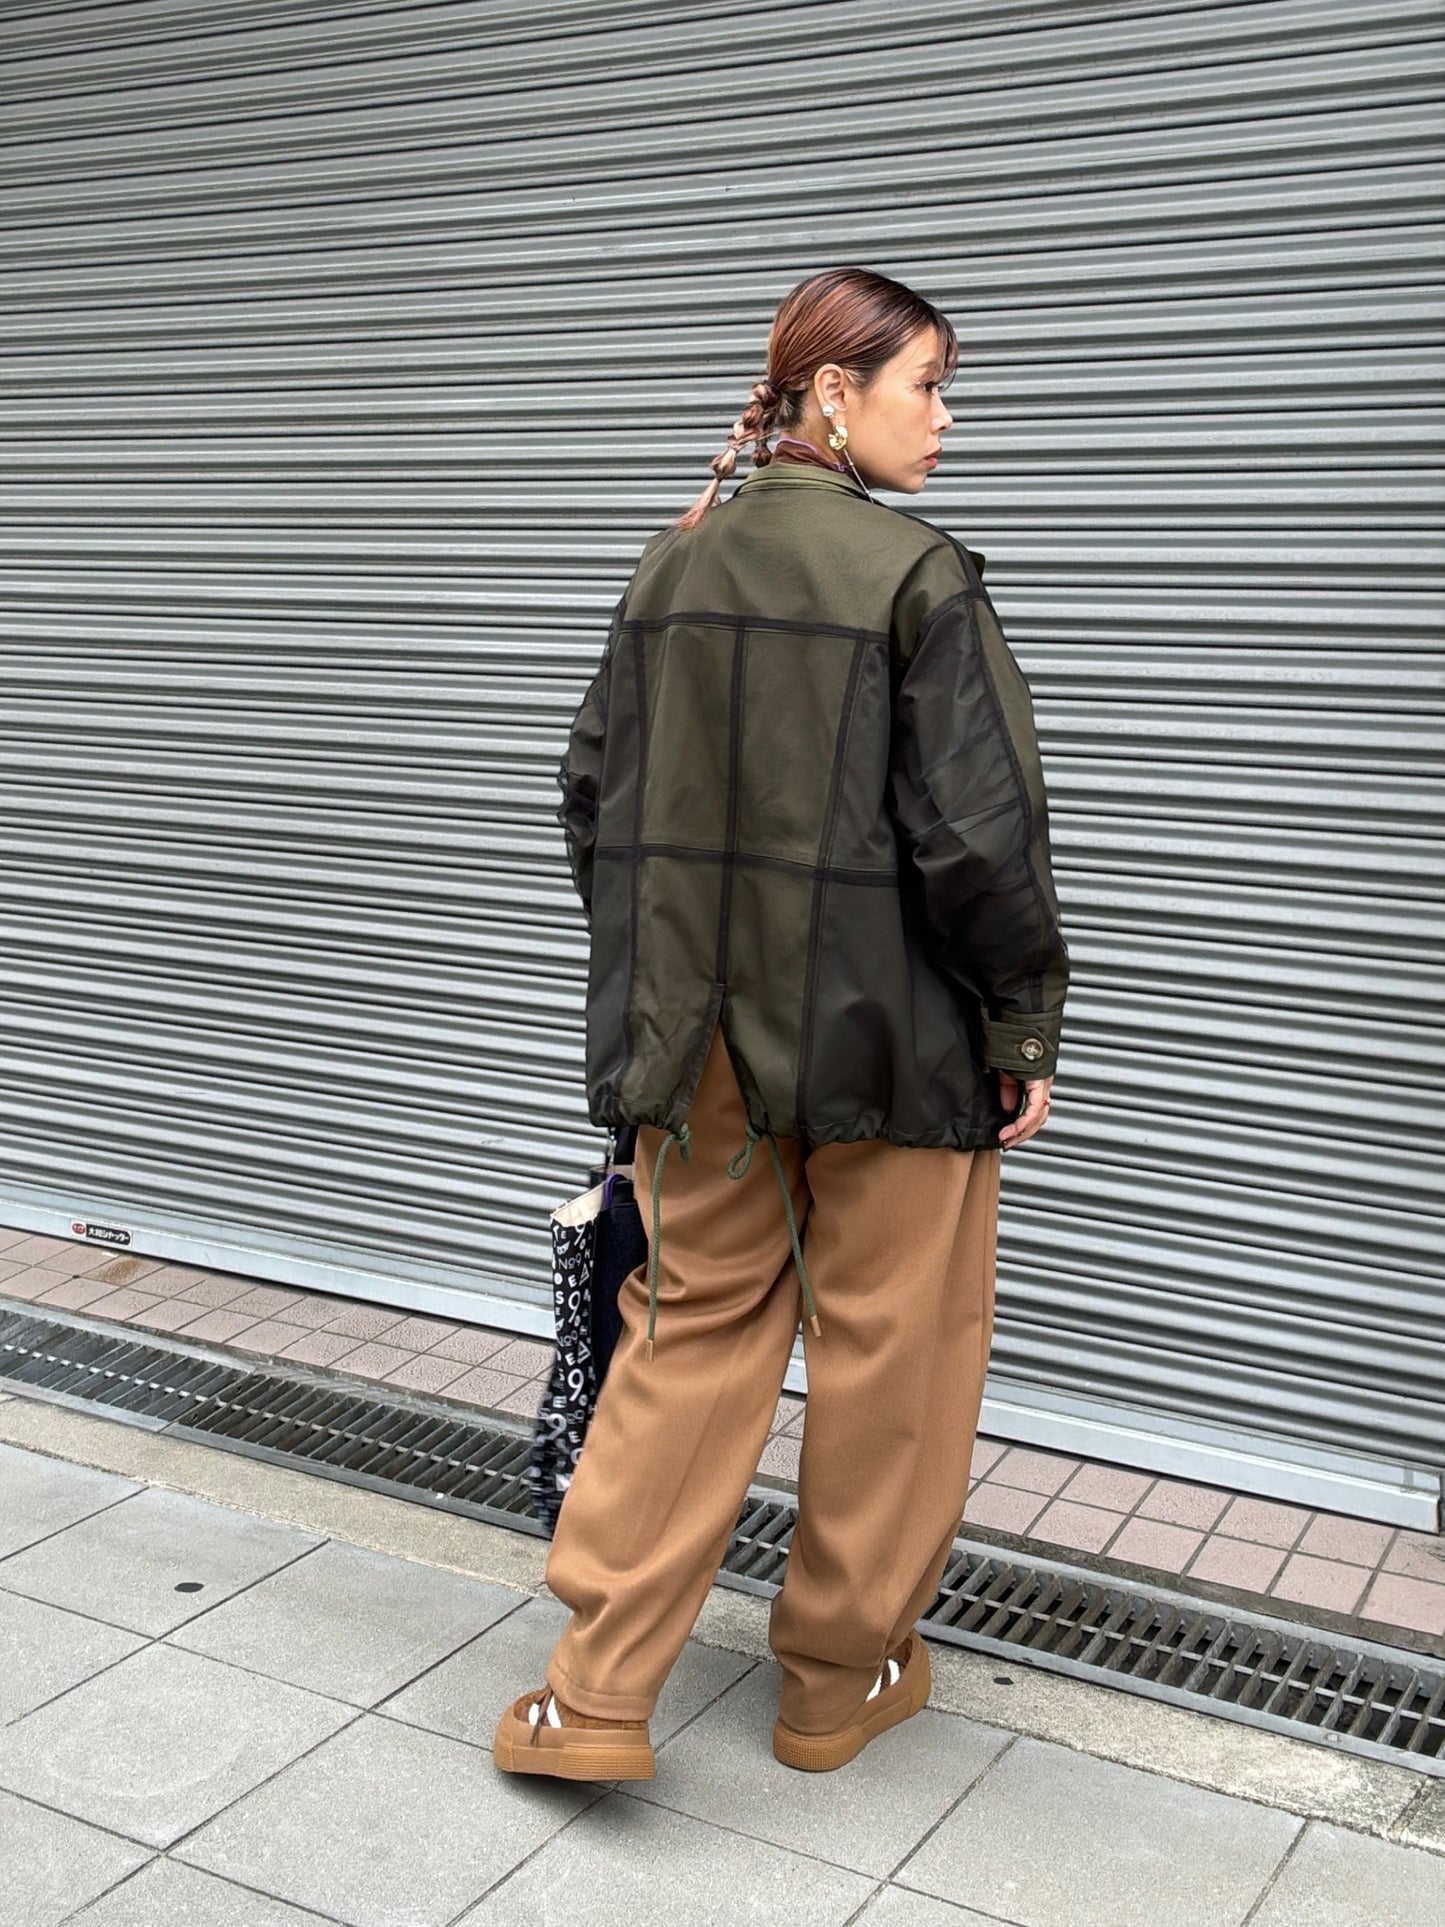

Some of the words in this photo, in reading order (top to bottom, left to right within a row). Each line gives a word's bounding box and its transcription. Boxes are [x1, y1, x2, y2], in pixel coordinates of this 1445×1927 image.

[560, 1230, 568, 1240] E
[567, 1274, 578, 1289] E
[555, 1290, 565, 1305] S
[568, 1290, 581, 1324] 9
[564, 1352, 576, 1367] E
[567, 1368, 585, 1402] 9
[567, 1430, 582, 1444] E
